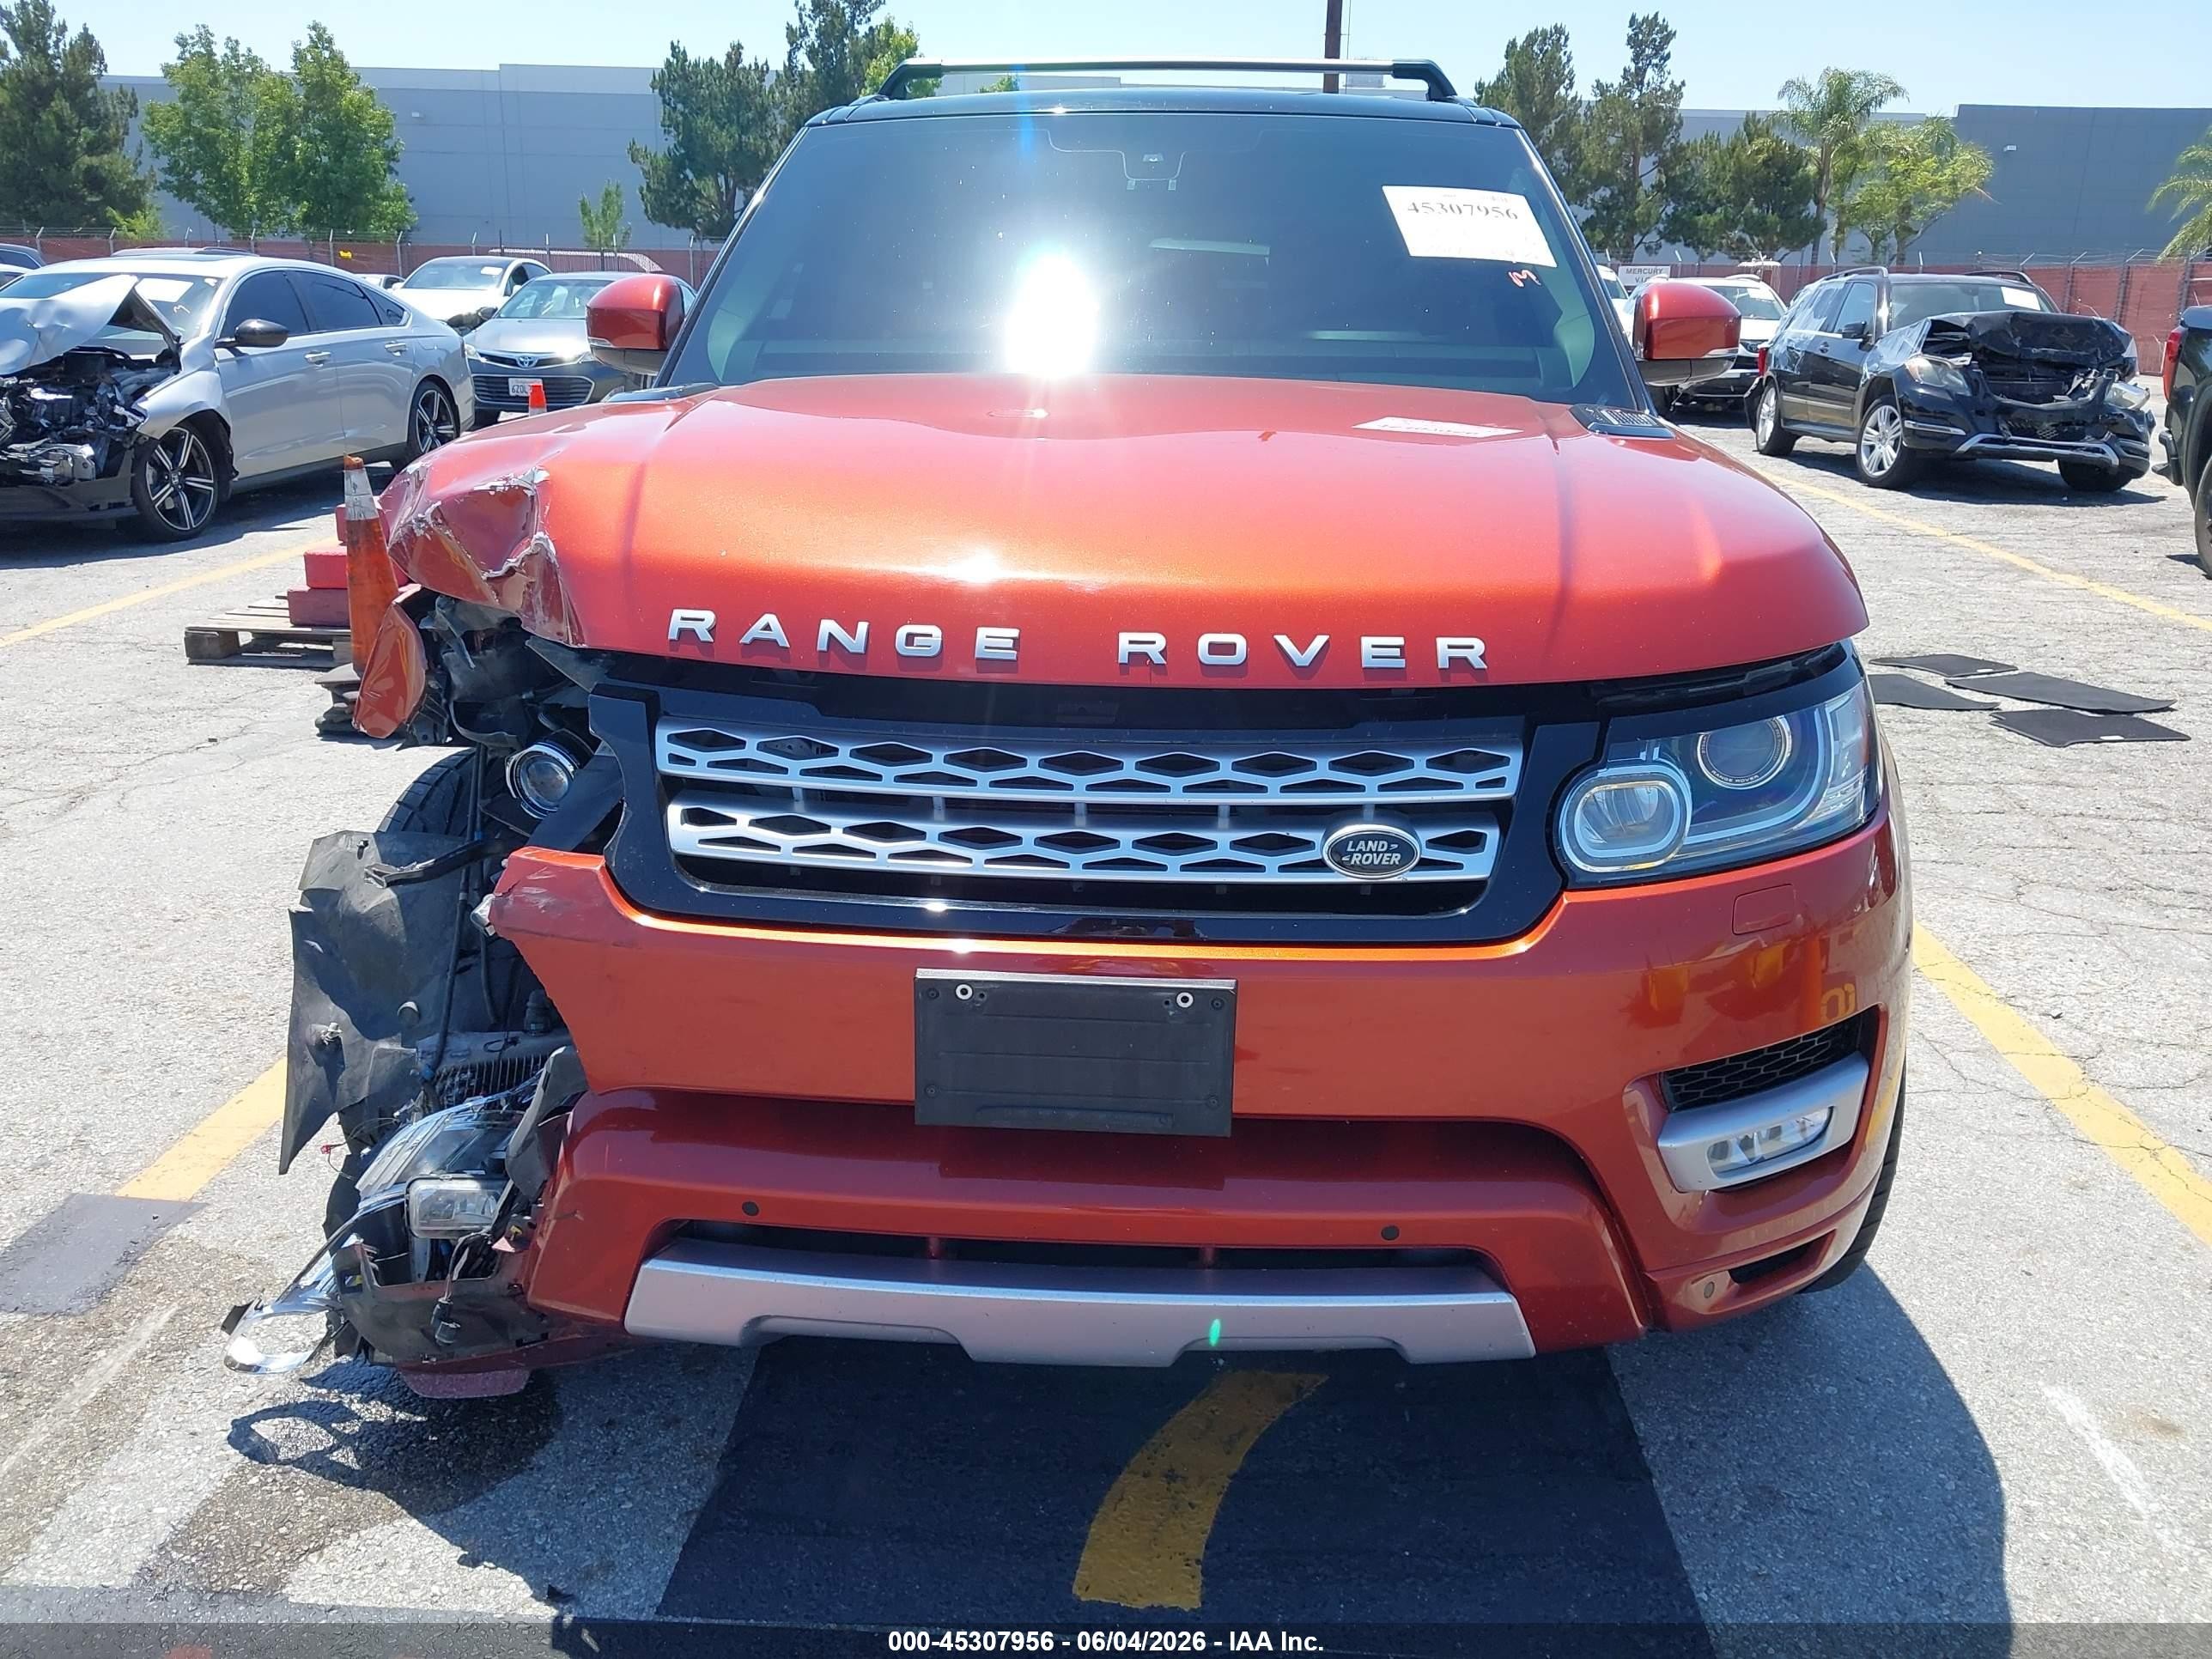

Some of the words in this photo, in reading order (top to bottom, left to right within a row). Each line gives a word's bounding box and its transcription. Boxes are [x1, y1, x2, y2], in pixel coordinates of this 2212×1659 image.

[1407, 201, 1519, 220] 45307956
[668, 608, 1021, 661] RANGE
[1118, 631, 1489, 671] ROVER
[1346, 840, 1389, 852] LAND
[1351, 853, 1402, 865] ROVER
